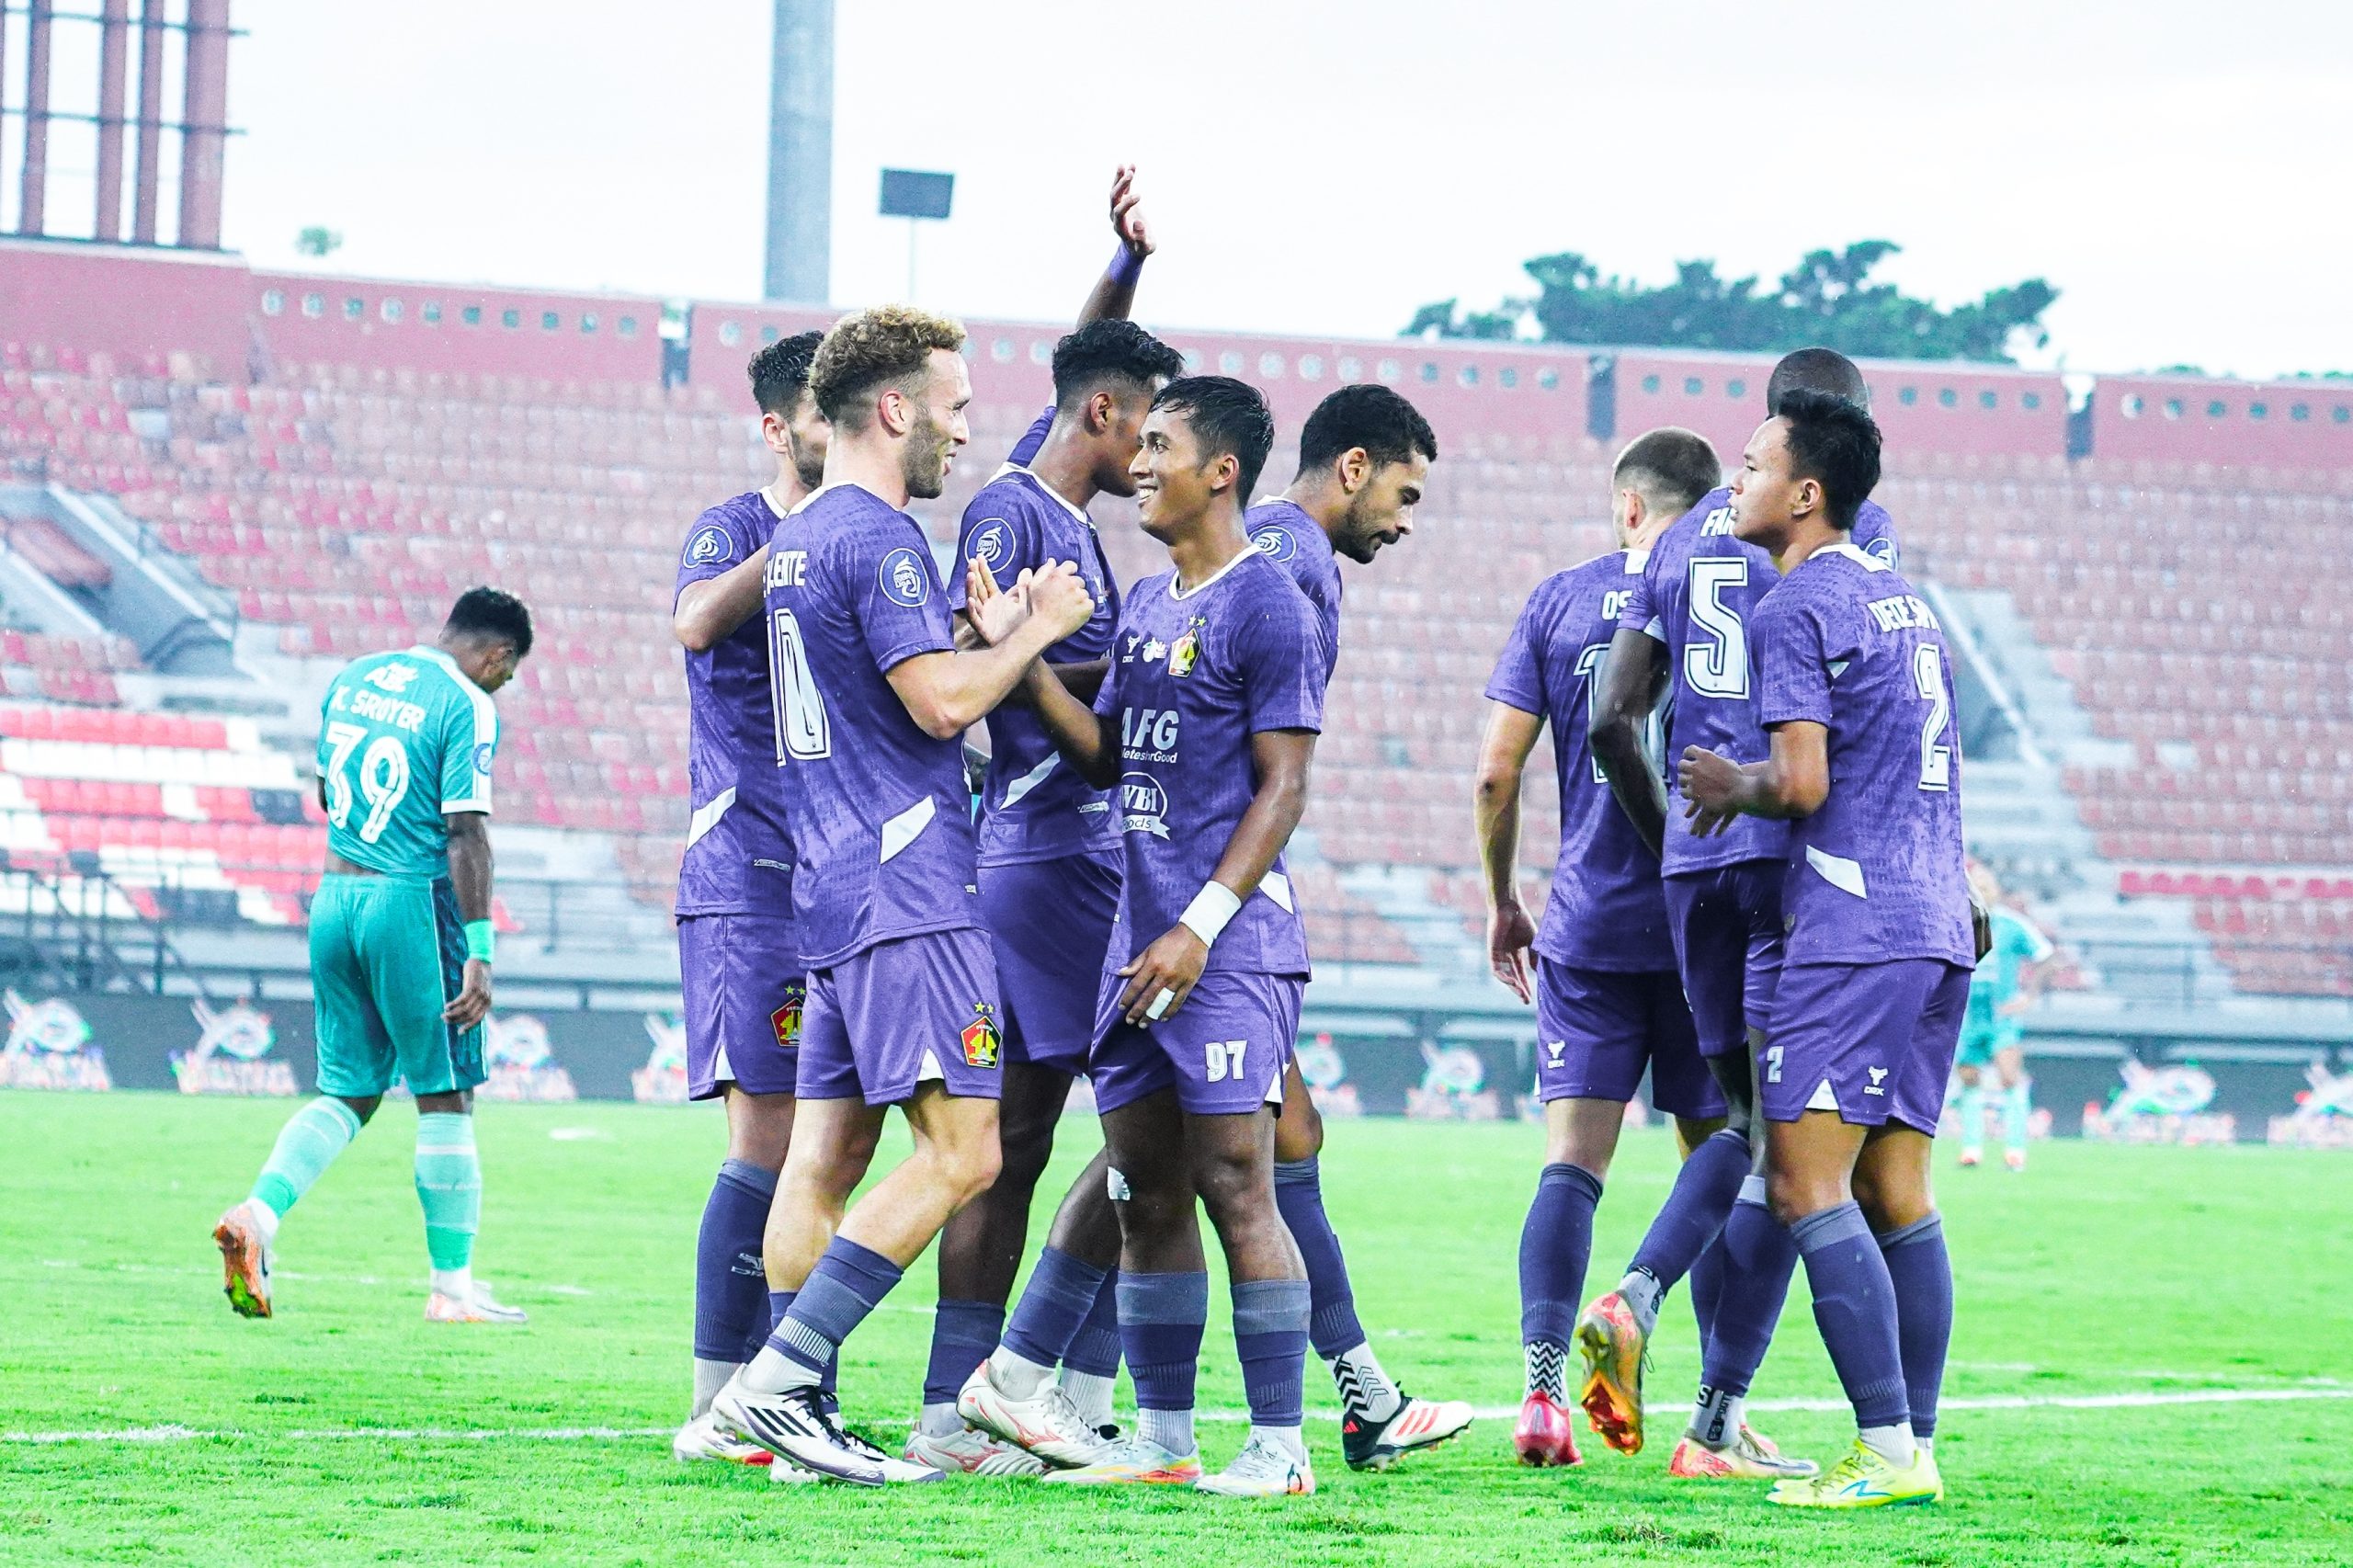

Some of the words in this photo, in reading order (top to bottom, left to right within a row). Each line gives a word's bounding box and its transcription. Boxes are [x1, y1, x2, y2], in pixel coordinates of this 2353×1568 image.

[1684, 556, 1750, 699] 5
[1914, 642, 1949, 791] 2
[324, 721, 410, 845] 39
[1205, 1040, 1248, 1083] 97
[1767, 1045, 1785, 1084] 2
